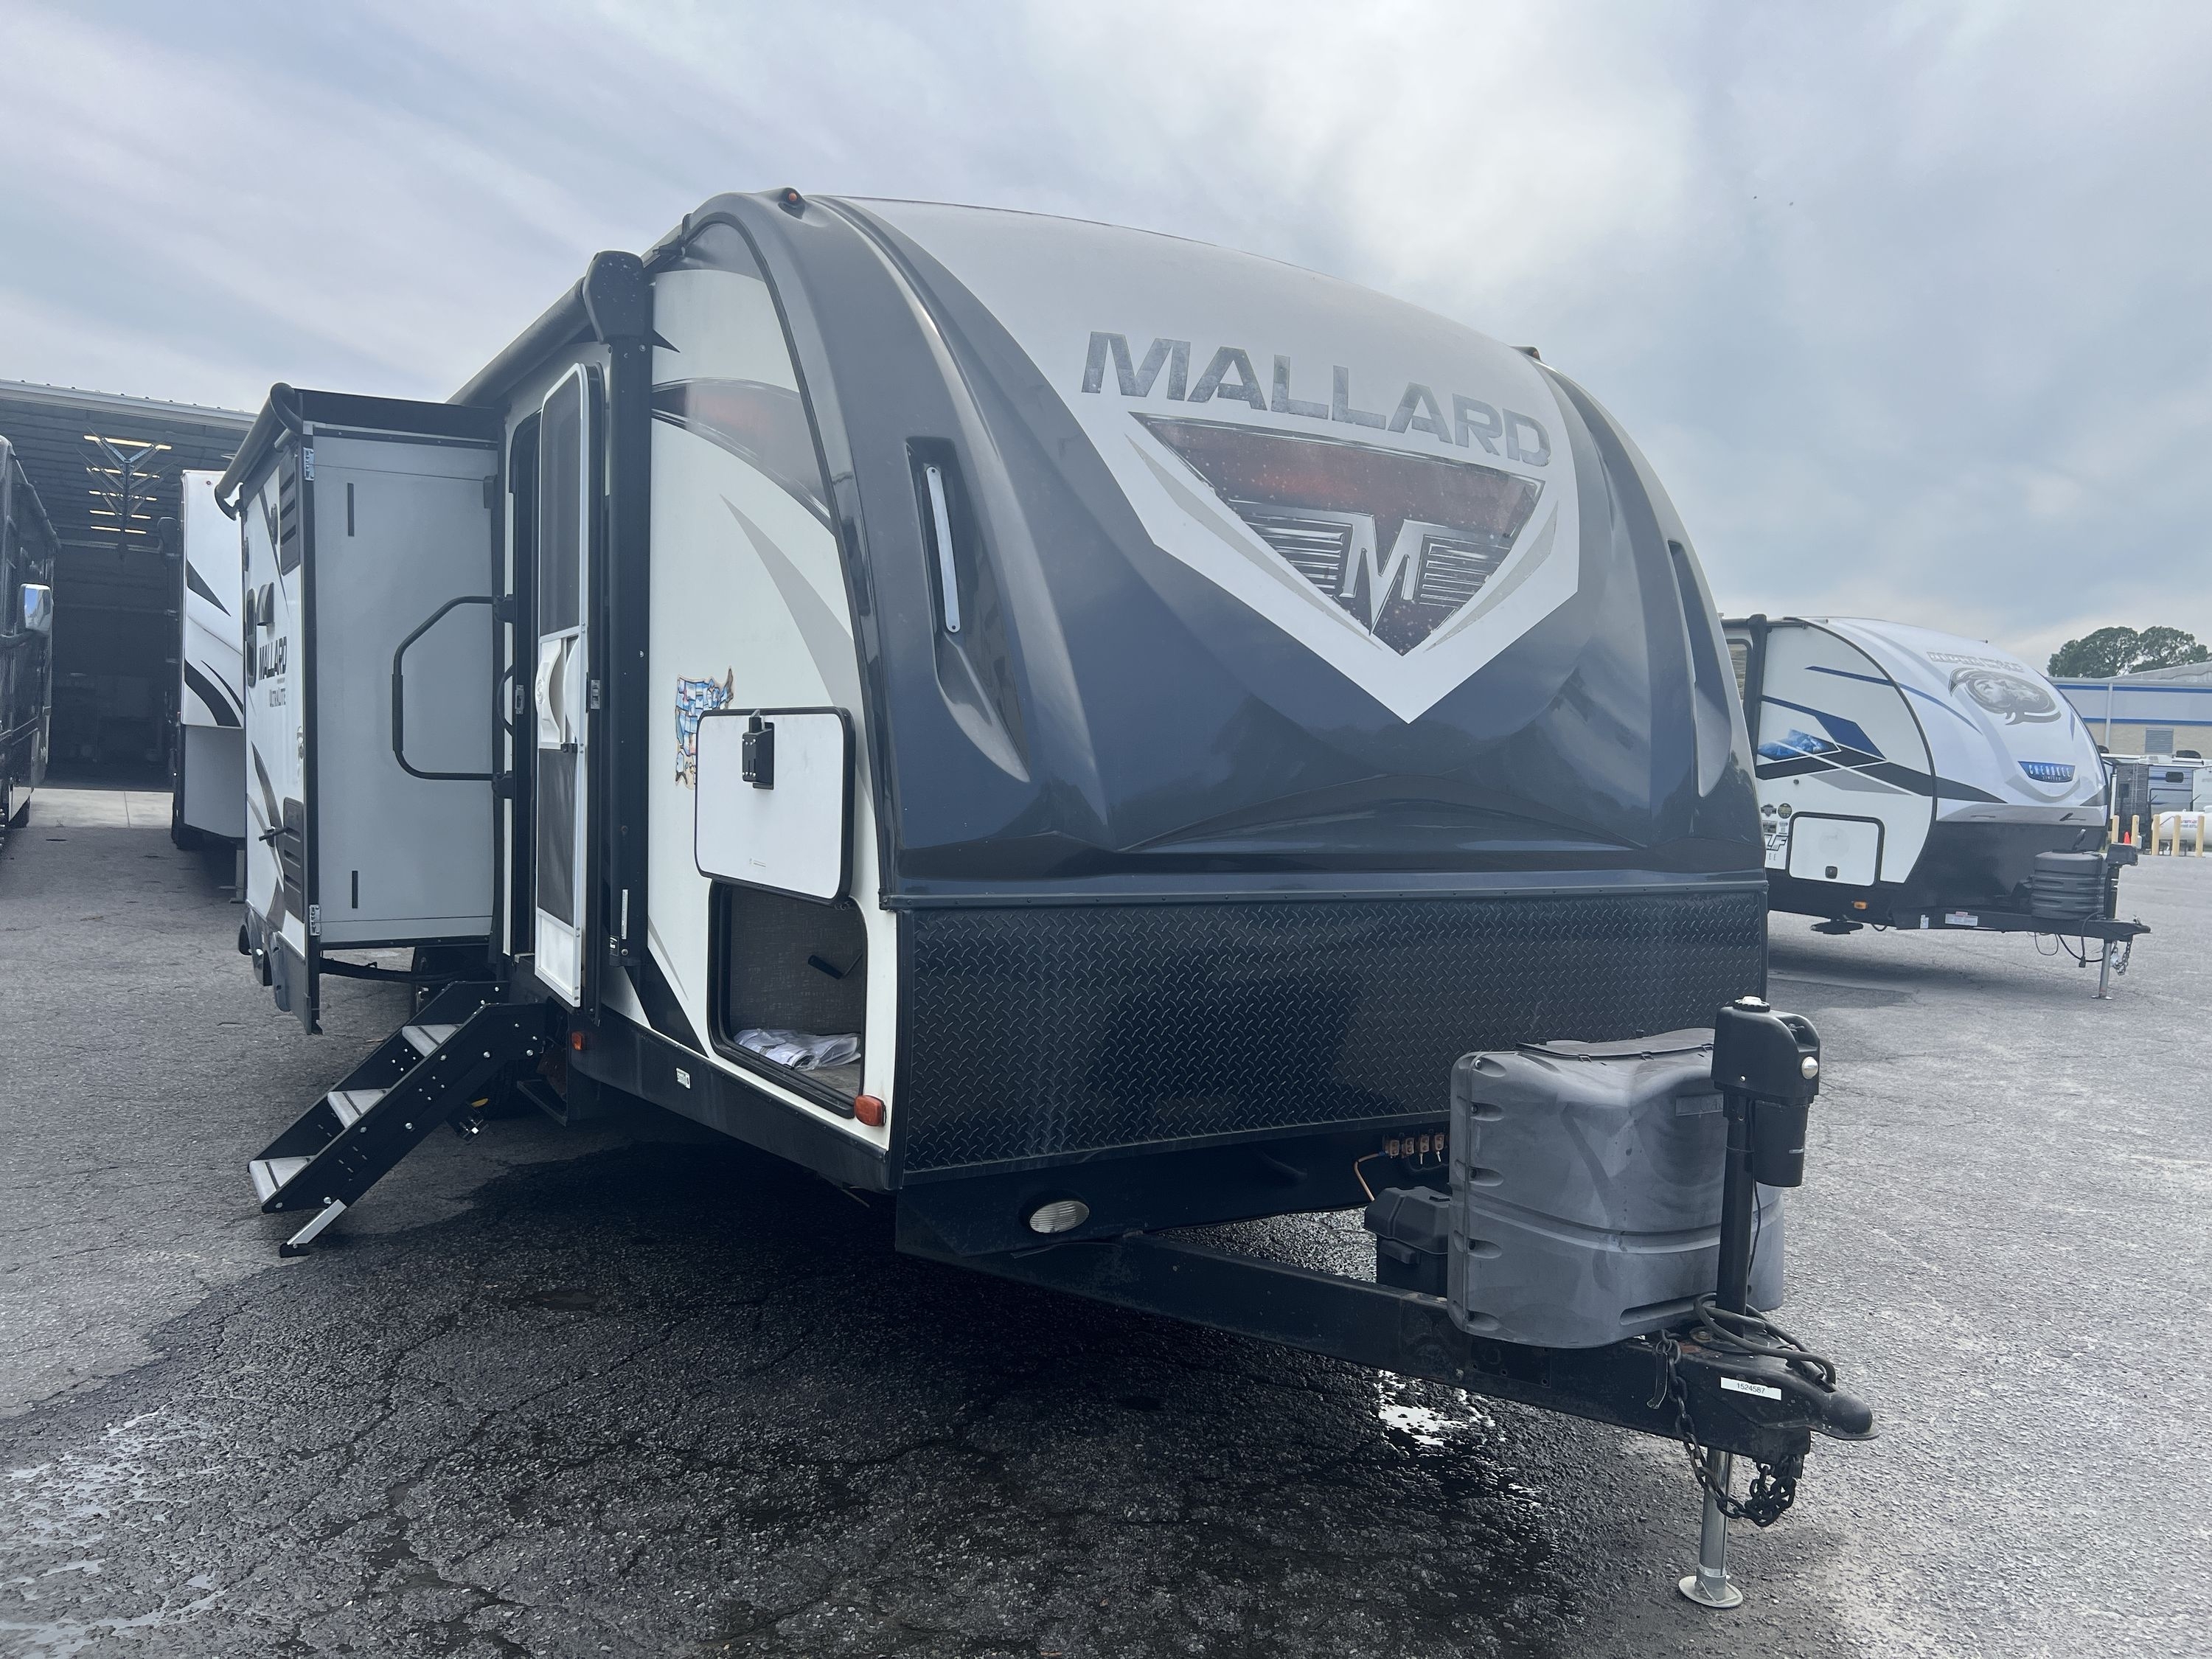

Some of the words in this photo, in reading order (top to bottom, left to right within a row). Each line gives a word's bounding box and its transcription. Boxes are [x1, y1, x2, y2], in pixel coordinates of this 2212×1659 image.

[1081, 331, 1551, 467] MALLARD
[259, 636, 287, 681] MALLARD
[2028, 764, 2070, 777] CHEROKEE
[1736, 1382, 1765, 1394] 1524587
